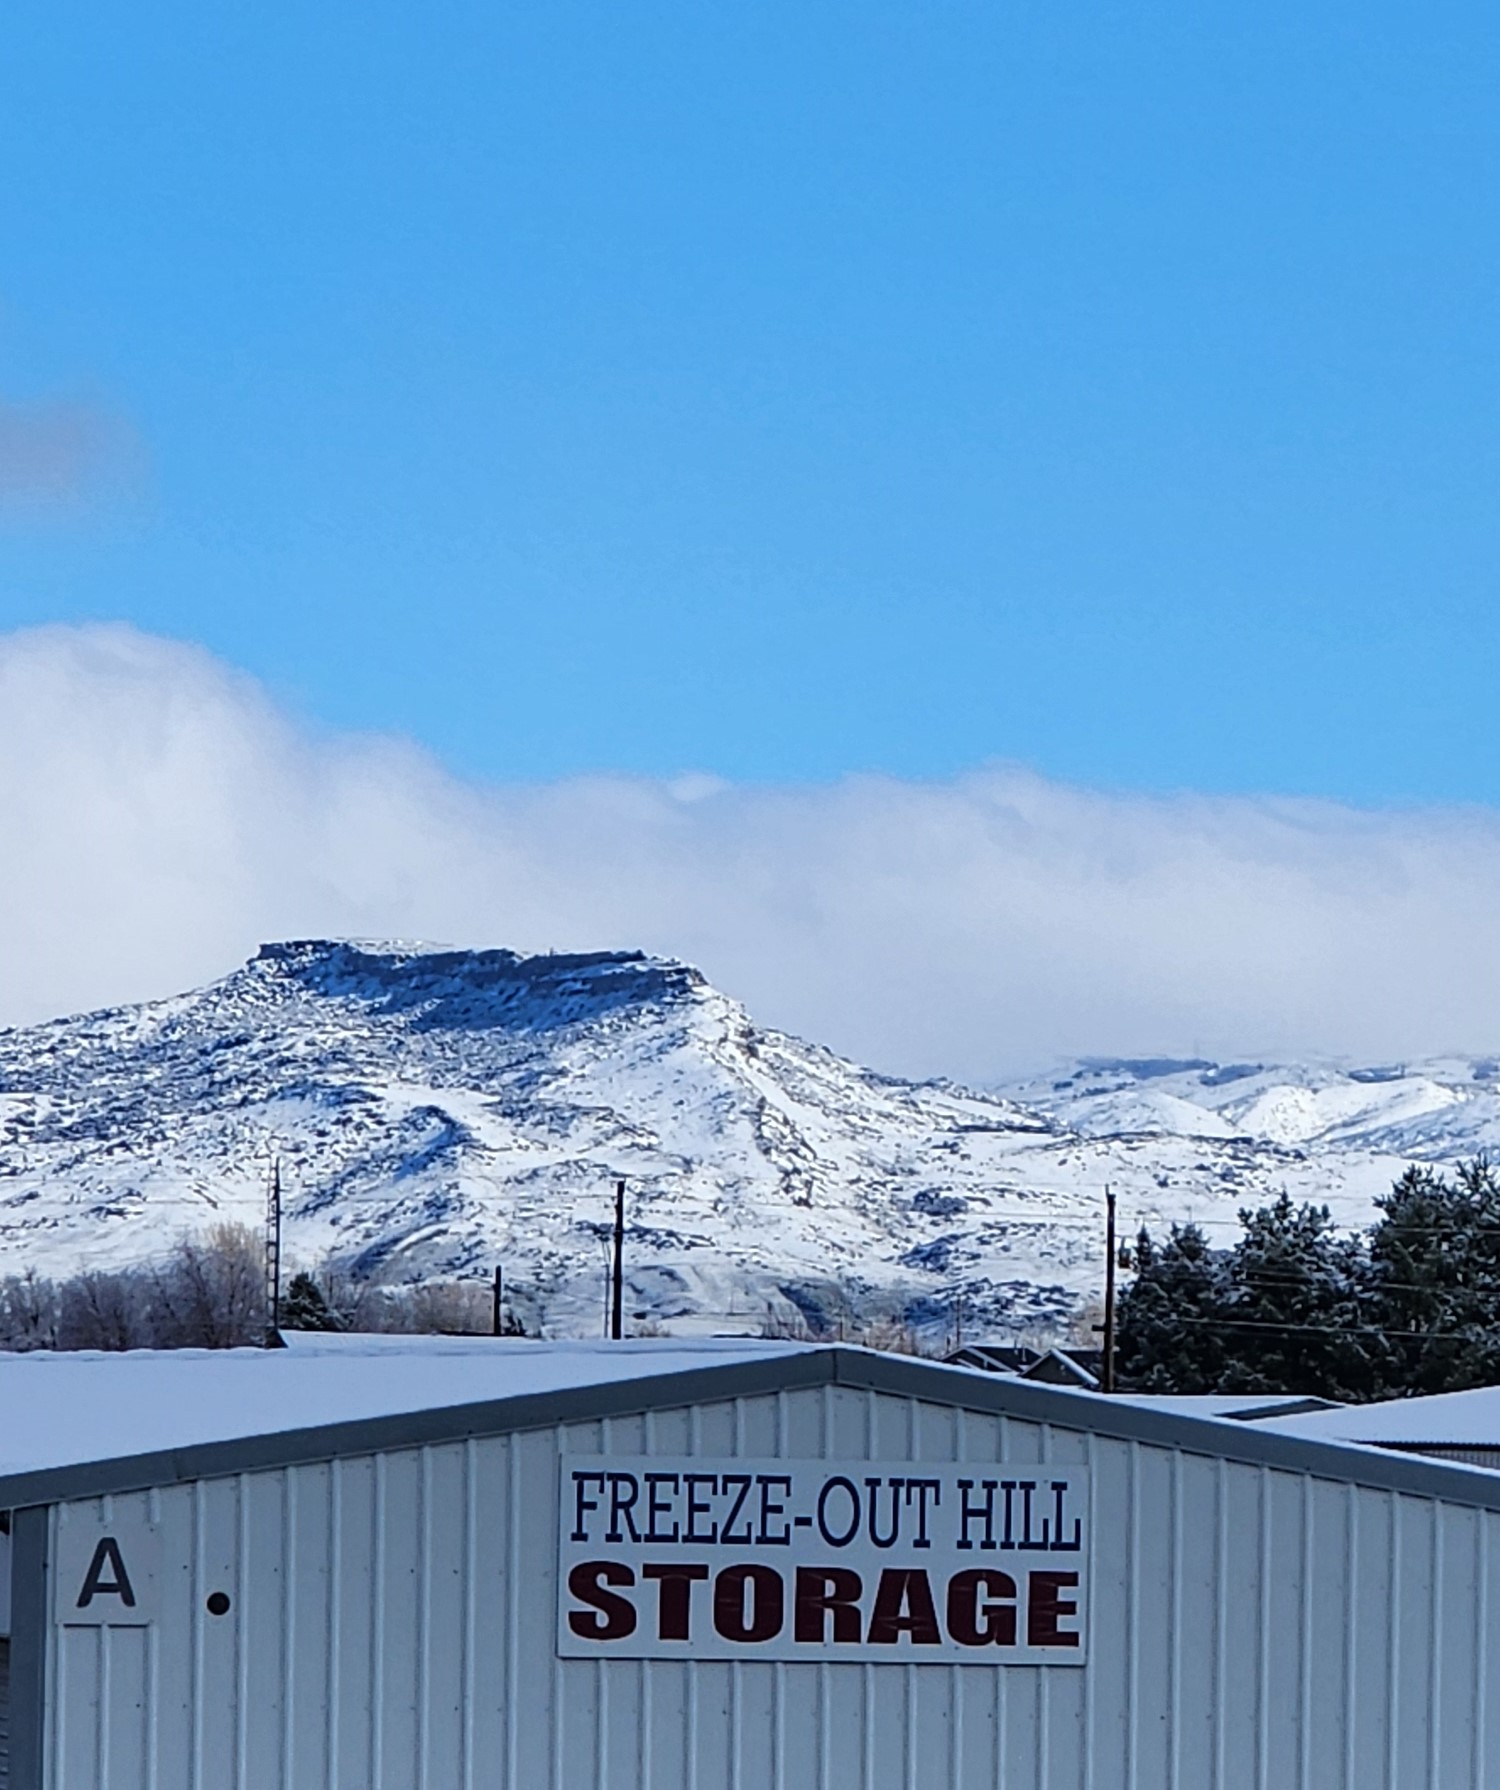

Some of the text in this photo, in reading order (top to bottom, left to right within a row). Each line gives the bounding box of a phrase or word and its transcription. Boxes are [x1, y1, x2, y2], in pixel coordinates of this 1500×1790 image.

[570, 1471, 1081, 1551] FREEZE-OUT HILL
[76, 1536, 136, 1608] A
[568, 1560, 1080, 1647] STORAGE
